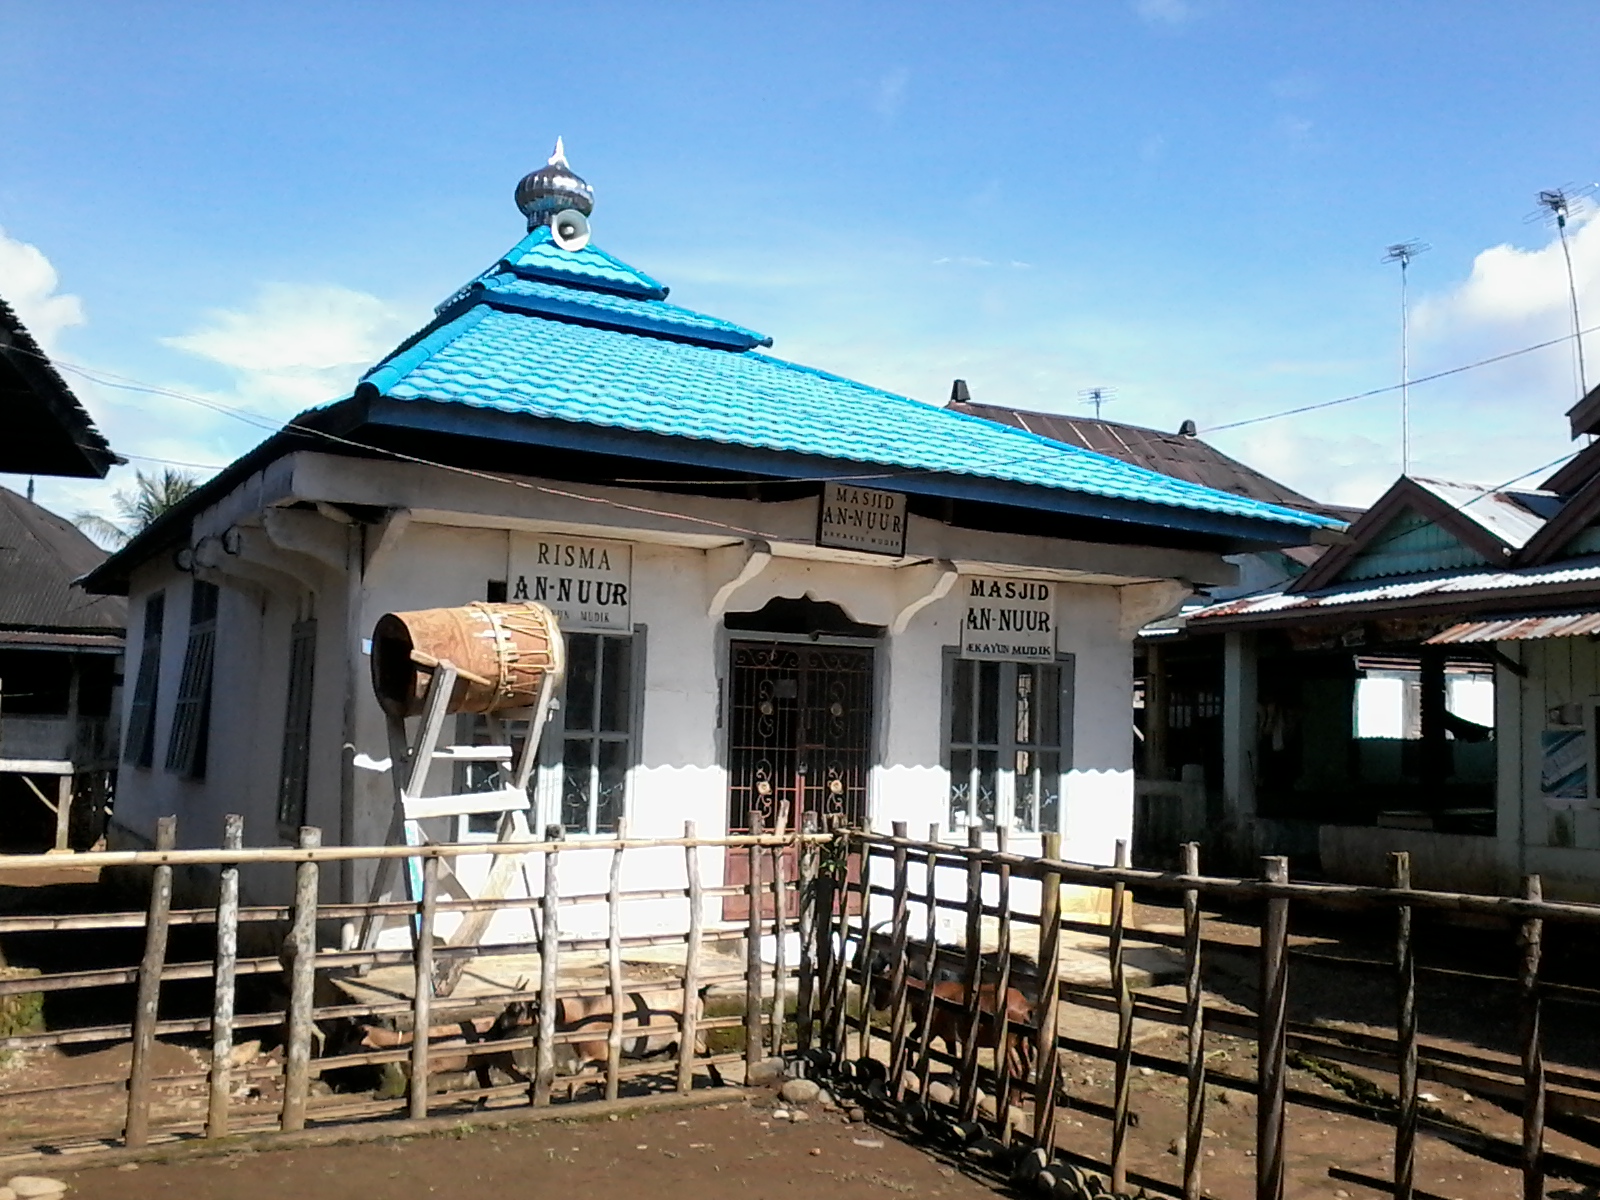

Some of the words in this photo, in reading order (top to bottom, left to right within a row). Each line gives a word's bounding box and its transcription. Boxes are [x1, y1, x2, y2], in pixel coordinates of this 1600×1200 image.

[836, 487, 894, 510] MASJID
[823, 506, 901, 533] AN-NUUR
[537, 542, 611, 571] RISMA
[513, 575, 628, 607] AN-NUUR
[969, 579, 1049, 601] MASJID
[581, 610, 610, 623] MUDIK
[966, 607, 1051, 633] AN-NUUR
[1011, 646, 1051, 656] MUDIK
